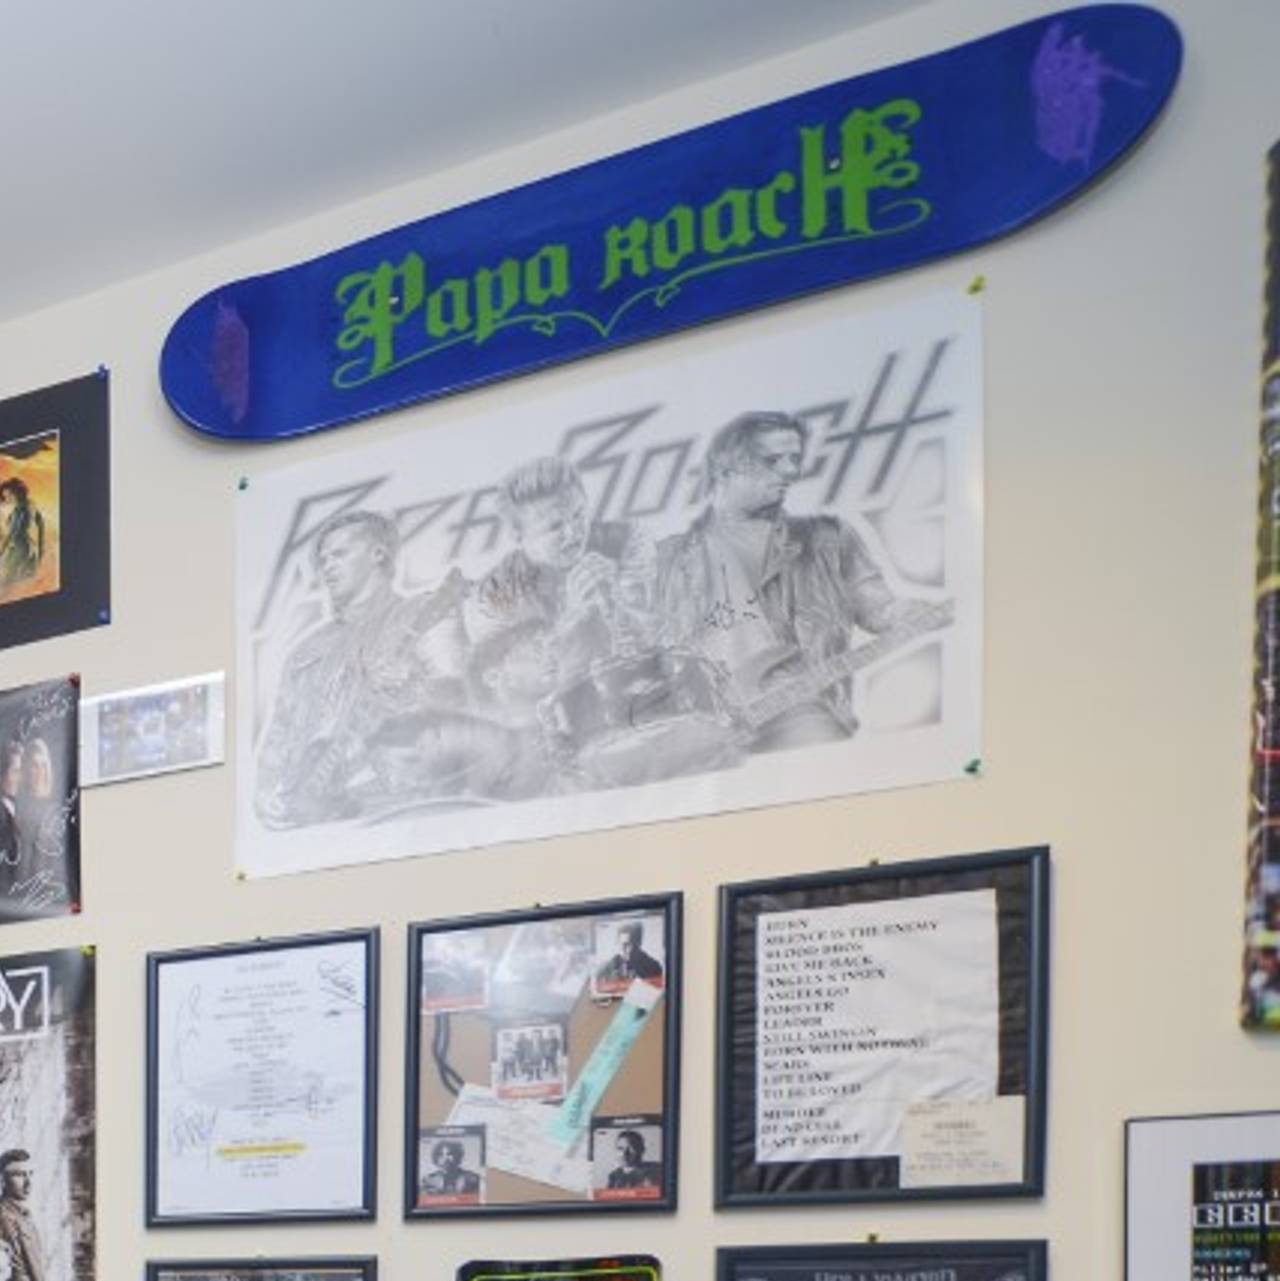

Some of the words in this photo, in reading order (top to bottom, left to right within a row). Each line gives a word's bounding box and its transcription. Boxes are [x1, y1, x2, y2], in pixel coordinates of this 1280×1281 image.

[335, 243, 569, 376] Papa
[850, 926, 878, 938] THE
[884, 920, 938, 934] ENEMY
[829, 955, 873, 968] BACK
[764, 1001, 835, 1015] FOREVER
[764, 1017, 822, 1030] LEADER
[809, 1042, 853, 1054] WITH
